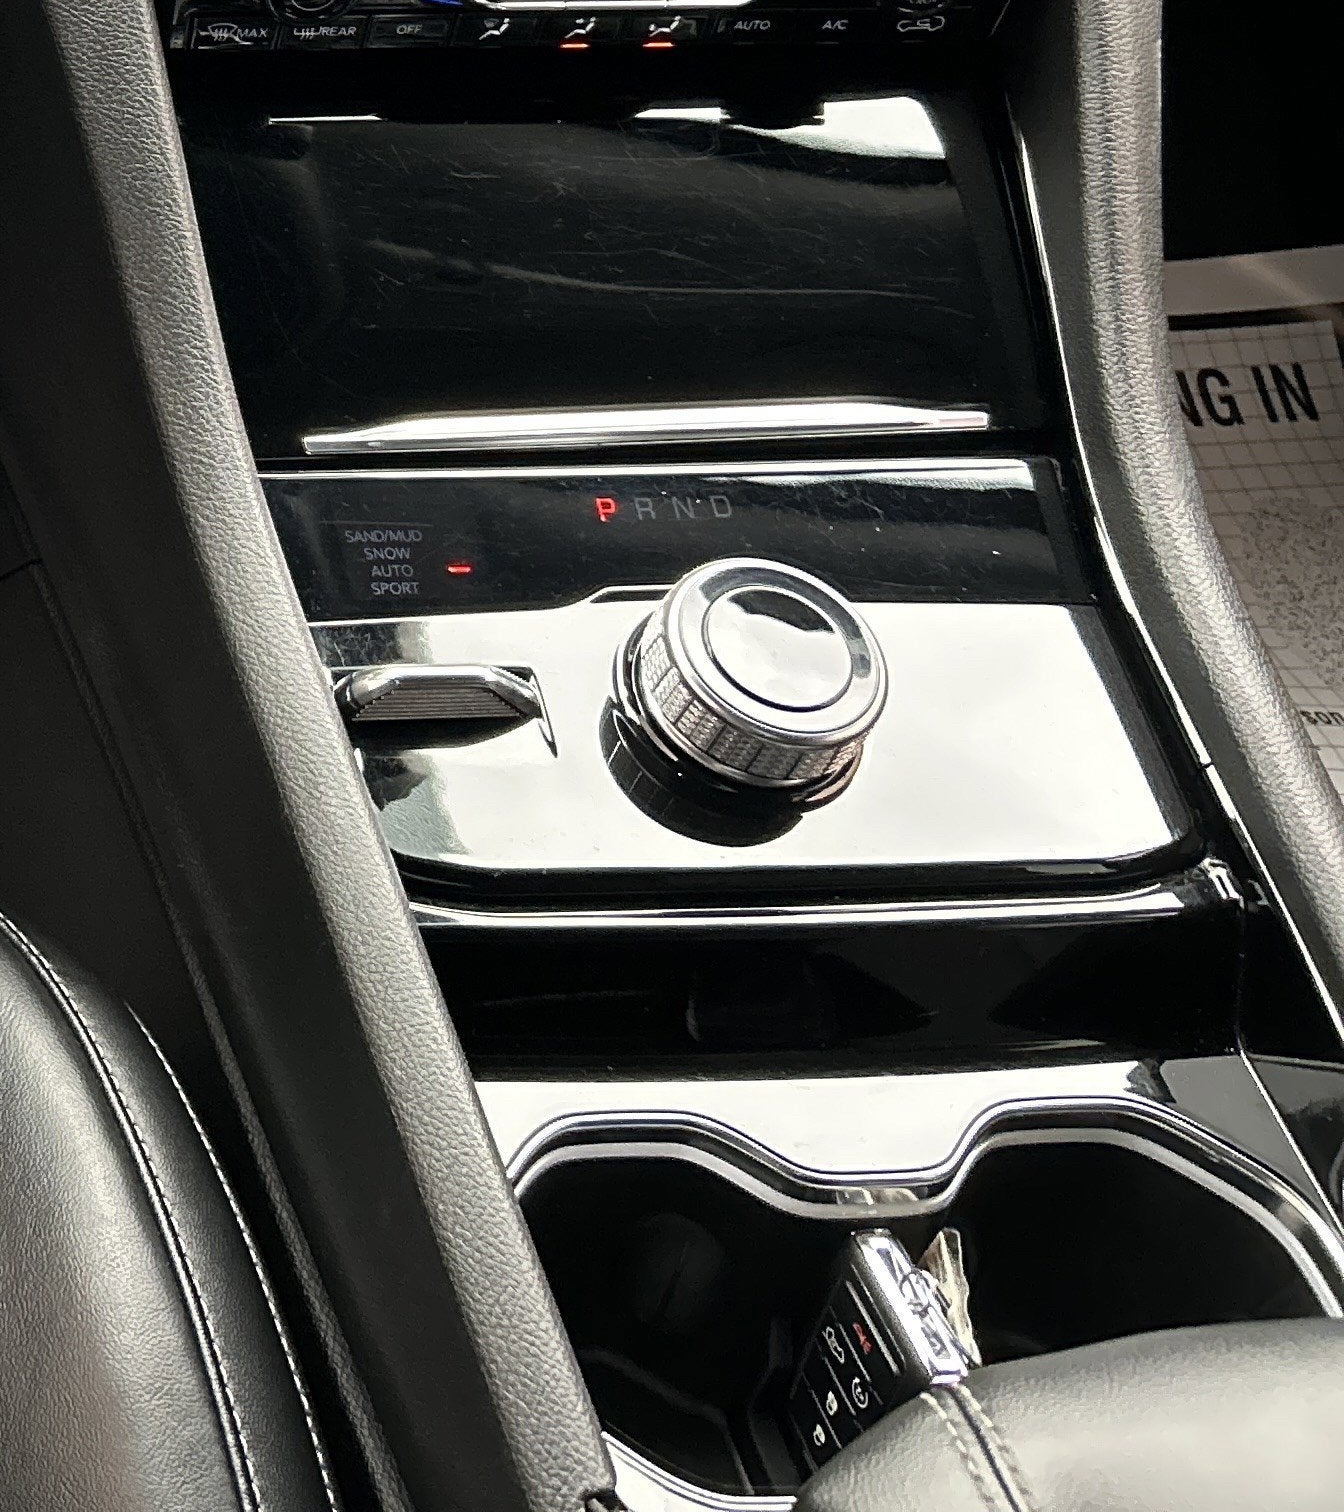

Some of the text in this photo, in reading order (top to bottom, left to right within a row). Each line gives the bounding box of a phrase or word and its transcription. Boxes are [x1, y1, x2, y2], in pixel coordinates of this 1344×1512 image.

[323, 26, 357, 36] REAR
[396, 24, 423, 35] OFF
[733, 20, 772, 31] AUTO
[821, 19, 849, 30] A/C
[236, 27, 269, 39] MAX
[1251, 361, 1320, 424] IN
[595, 495, 733, 523] P R N D
[344, 529, 423, 543] SAND/MUD
[363, 546, 411, 561] SNOW
[370, 563, 414, 578] AUTO
[370, 581, 420, 596] SPORT
